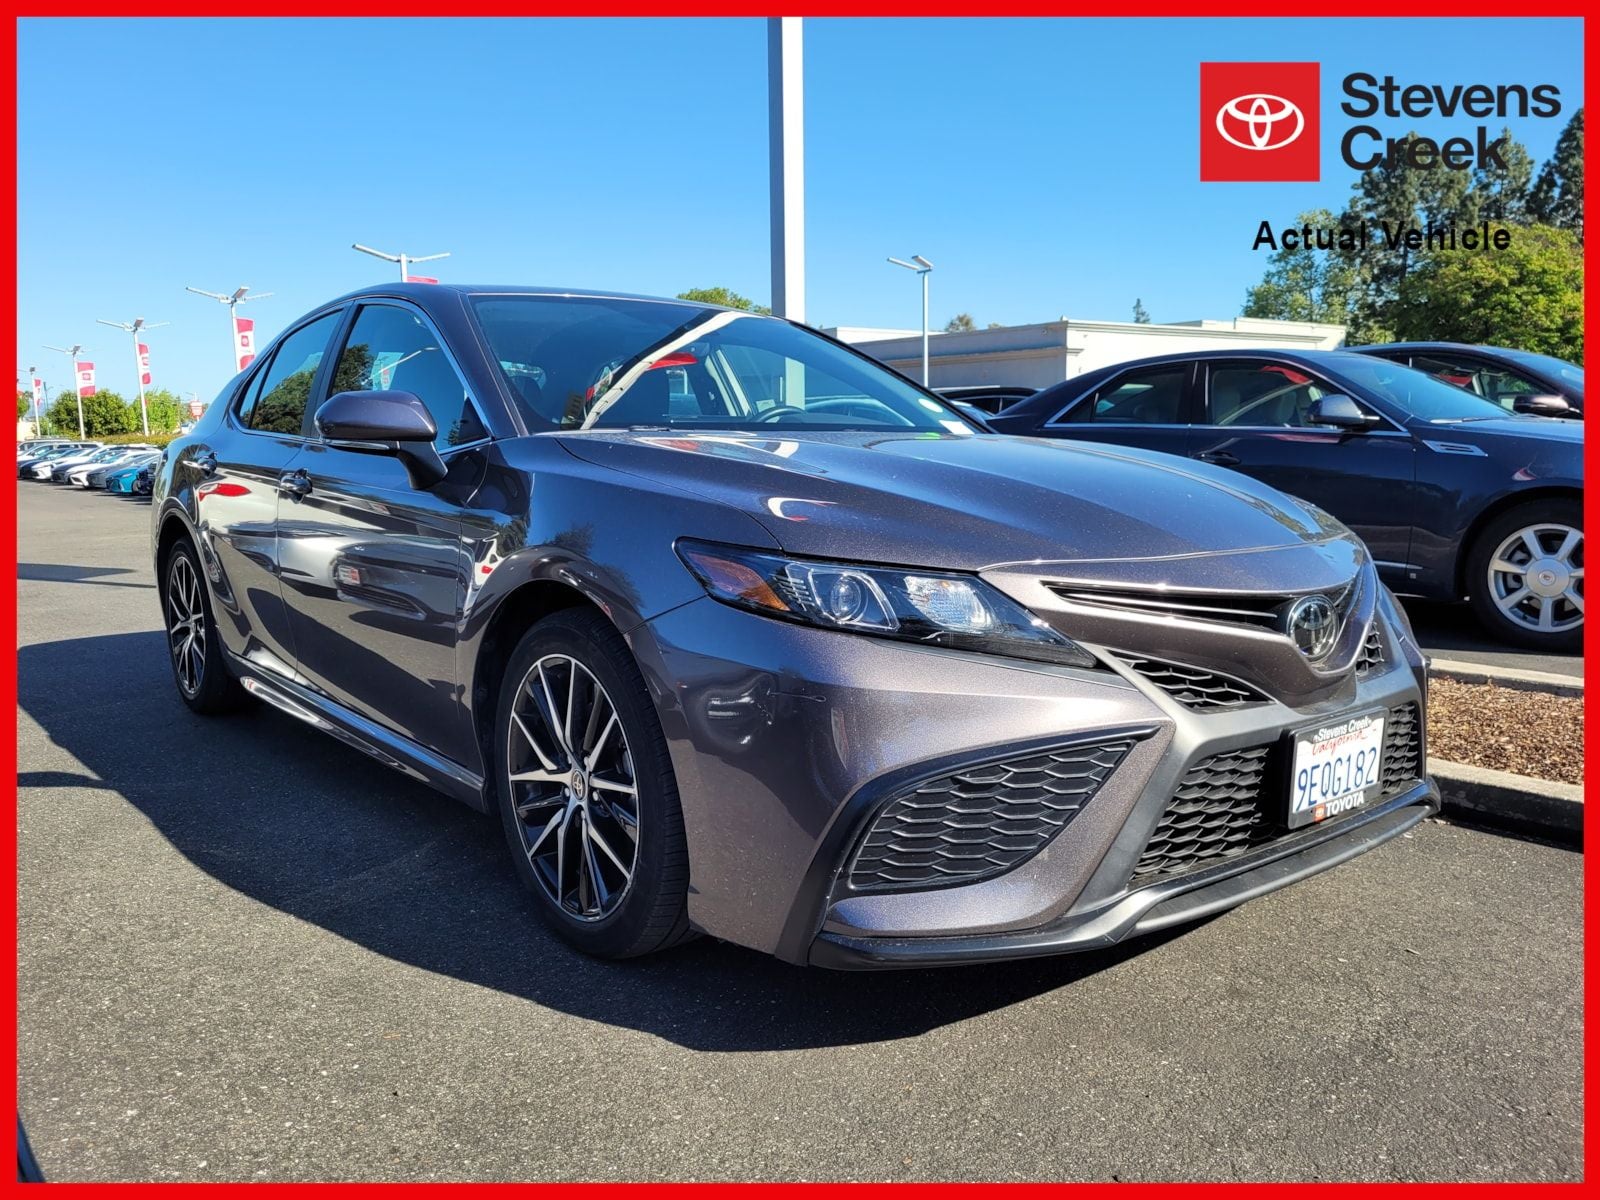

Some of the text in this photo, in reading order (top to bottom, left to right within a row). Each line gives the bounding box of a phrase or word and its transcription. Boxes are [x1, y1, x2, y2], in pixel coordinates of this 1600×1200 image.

[1318, 716, 1370, 741] Stevens Creek
[1326, 790, 1364, 817] TOYOTA
